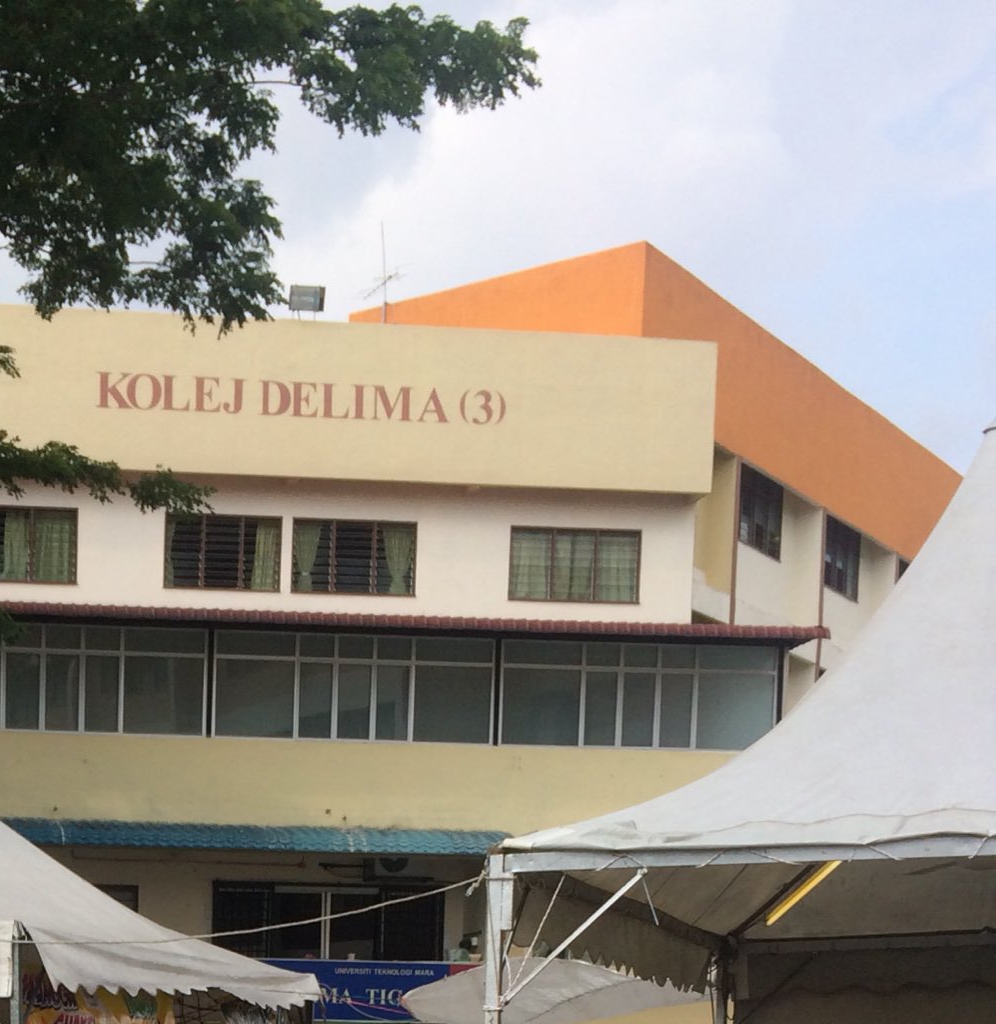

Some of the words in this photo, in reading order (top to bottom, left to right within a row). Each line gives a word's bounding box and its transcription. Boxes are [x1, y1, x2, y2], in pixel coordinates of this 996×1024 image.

[96, 371, 248, 415] KOLEJ
[259, 379, 450, 423] DELIMA
[459, 389, 507, 425] (3)
[335, 967, 372, 975] UNIVERSITI
[374, 968, 413, 976] TEKNOLOGI
[414, 969, 434, 977] MARA
